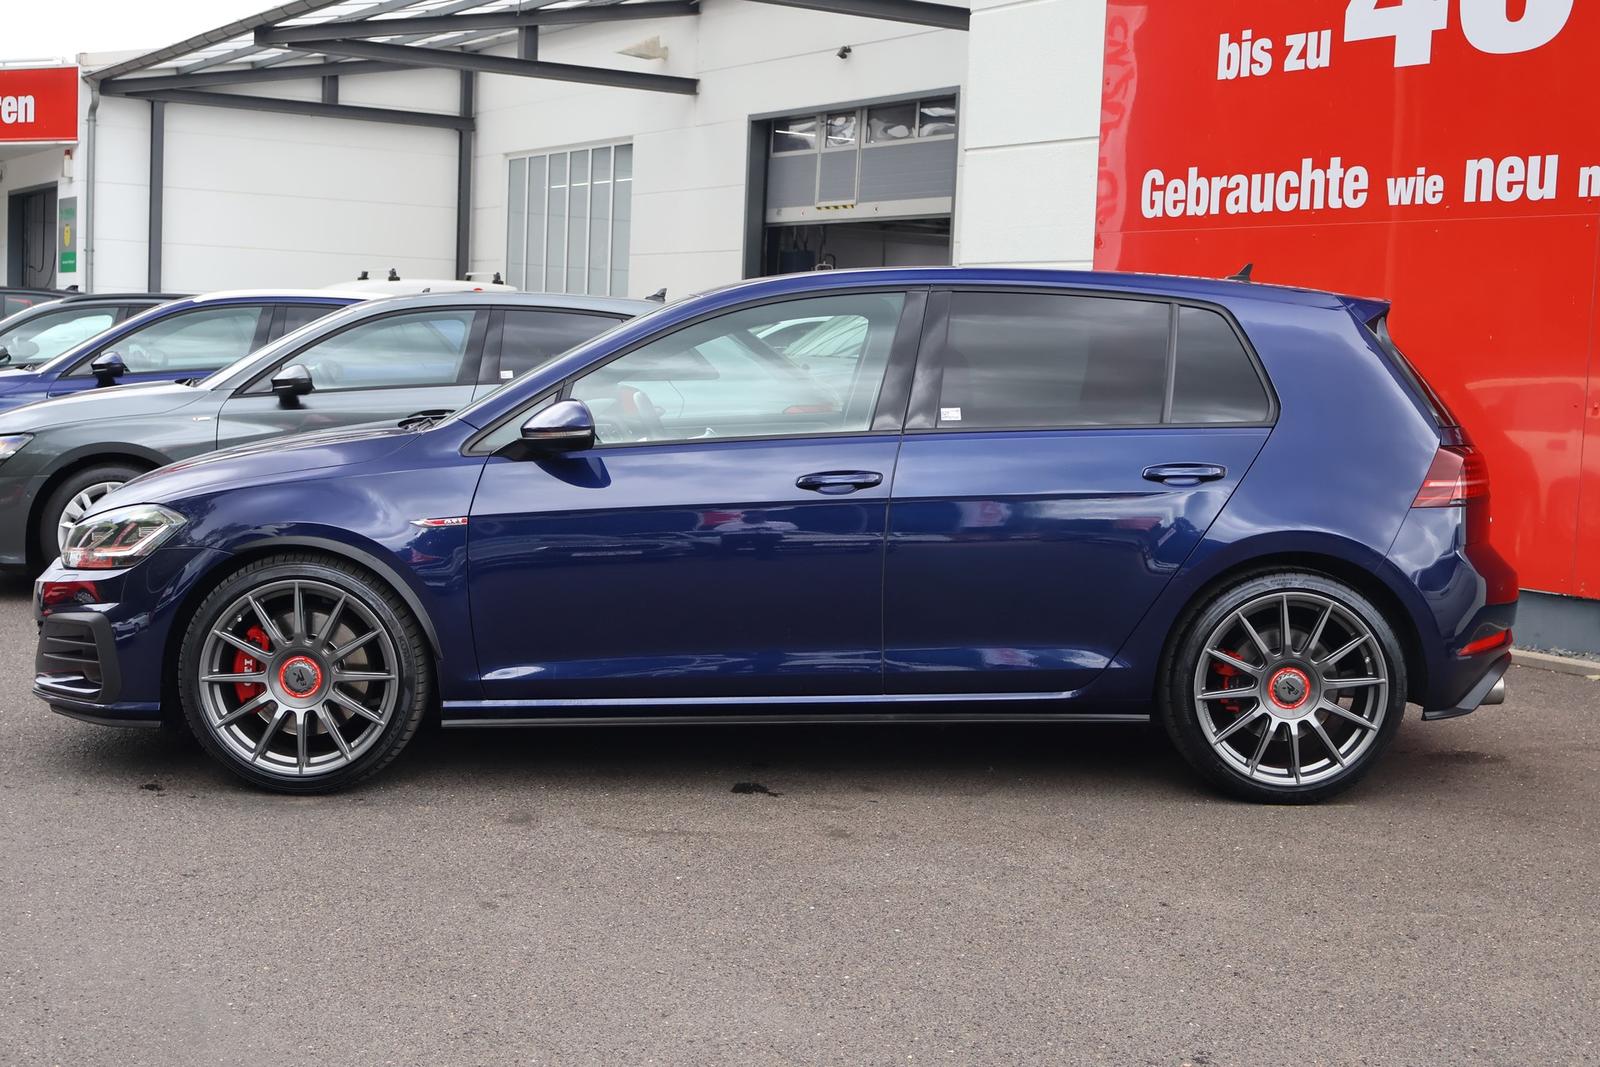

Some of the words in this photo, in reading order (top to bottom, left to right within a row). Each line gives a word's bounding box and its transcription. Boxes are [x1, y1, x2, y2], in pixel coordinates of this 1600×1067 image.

[1217, 29, 1272, 80] bis
[1284, 30, 1331, 71] zu
[0, 95, 35, 124] en
[1141, 157, 1368, 218] Gebrauchte
[1387, 167, 1444, 206] wie
[1464, 155, 1558, 202] neu
